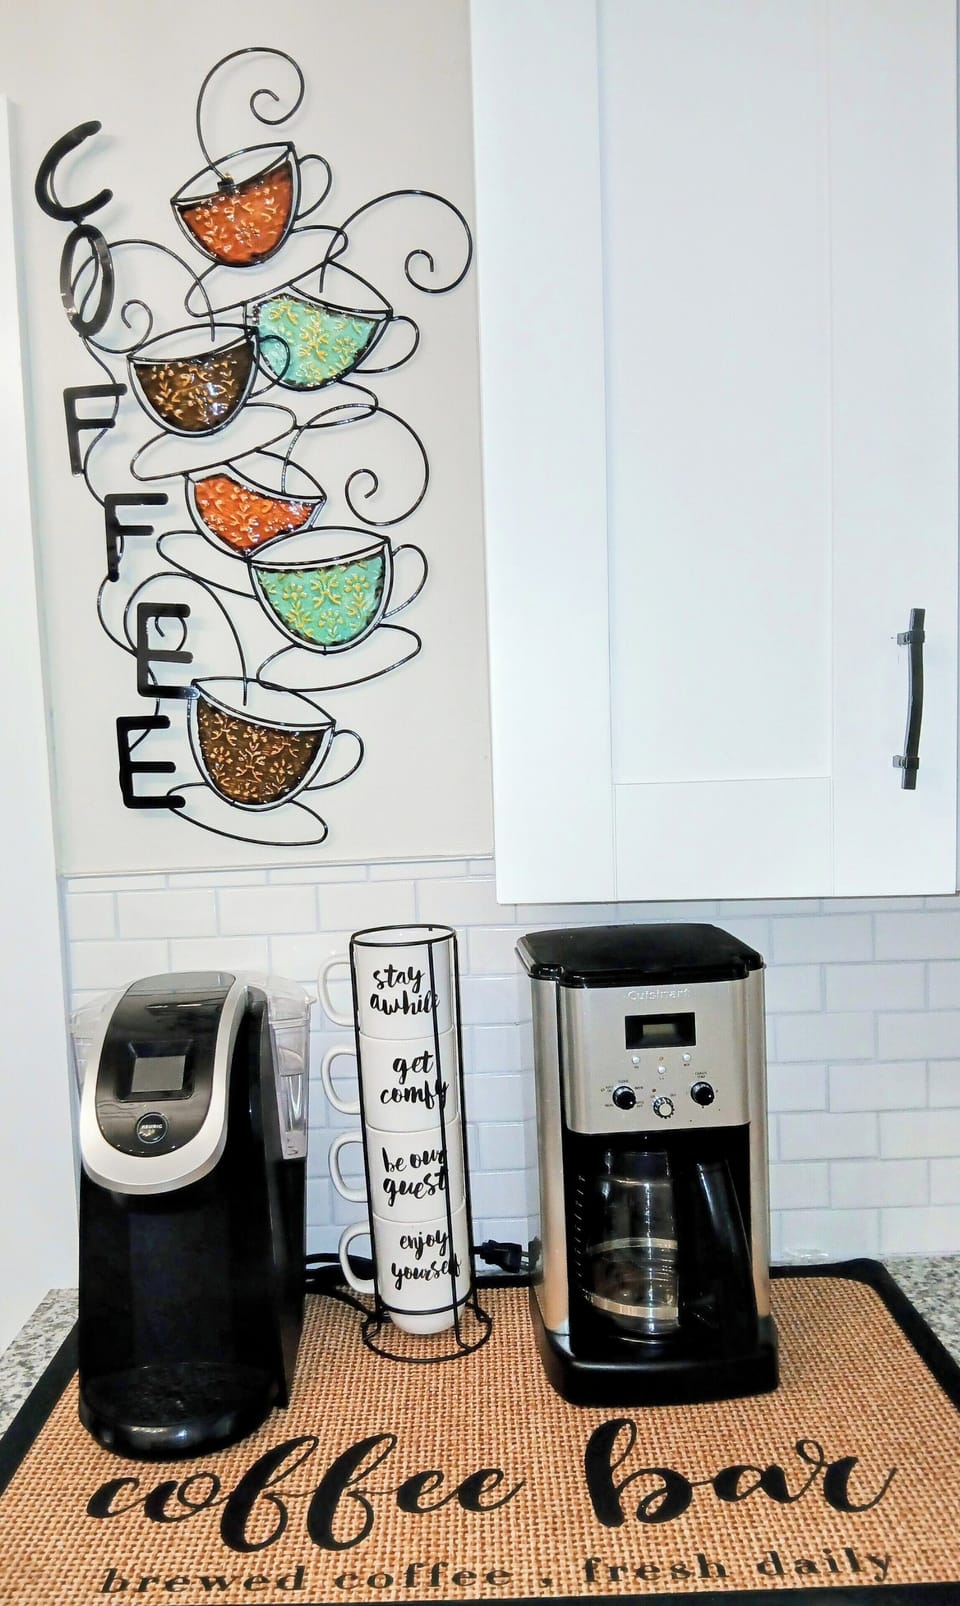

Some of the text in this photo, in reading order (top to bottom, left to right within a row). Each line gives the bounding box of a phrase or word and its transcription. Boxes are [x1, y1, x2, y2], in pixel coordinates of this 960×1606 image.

[373, 964, 425, 994] stay
[393, 1050, 434, 1085] get
[380, 1080, 450, 1110] comfy
[382, 1147, 407, 1173] be
[383, 1166, 449, 1207] guest
[400, 1230, 449, 1260] enjoy
[391, 1253, 462, 1290] yoursef
[86, 1418, 897, 1553] coffee bar
[101, 1566, 306, 1594] brewed
[334, 1562, 514, 1589] coffee
[582, 1552, 730, 1583] fresh
[757, 1547, 892, 1581] daily
